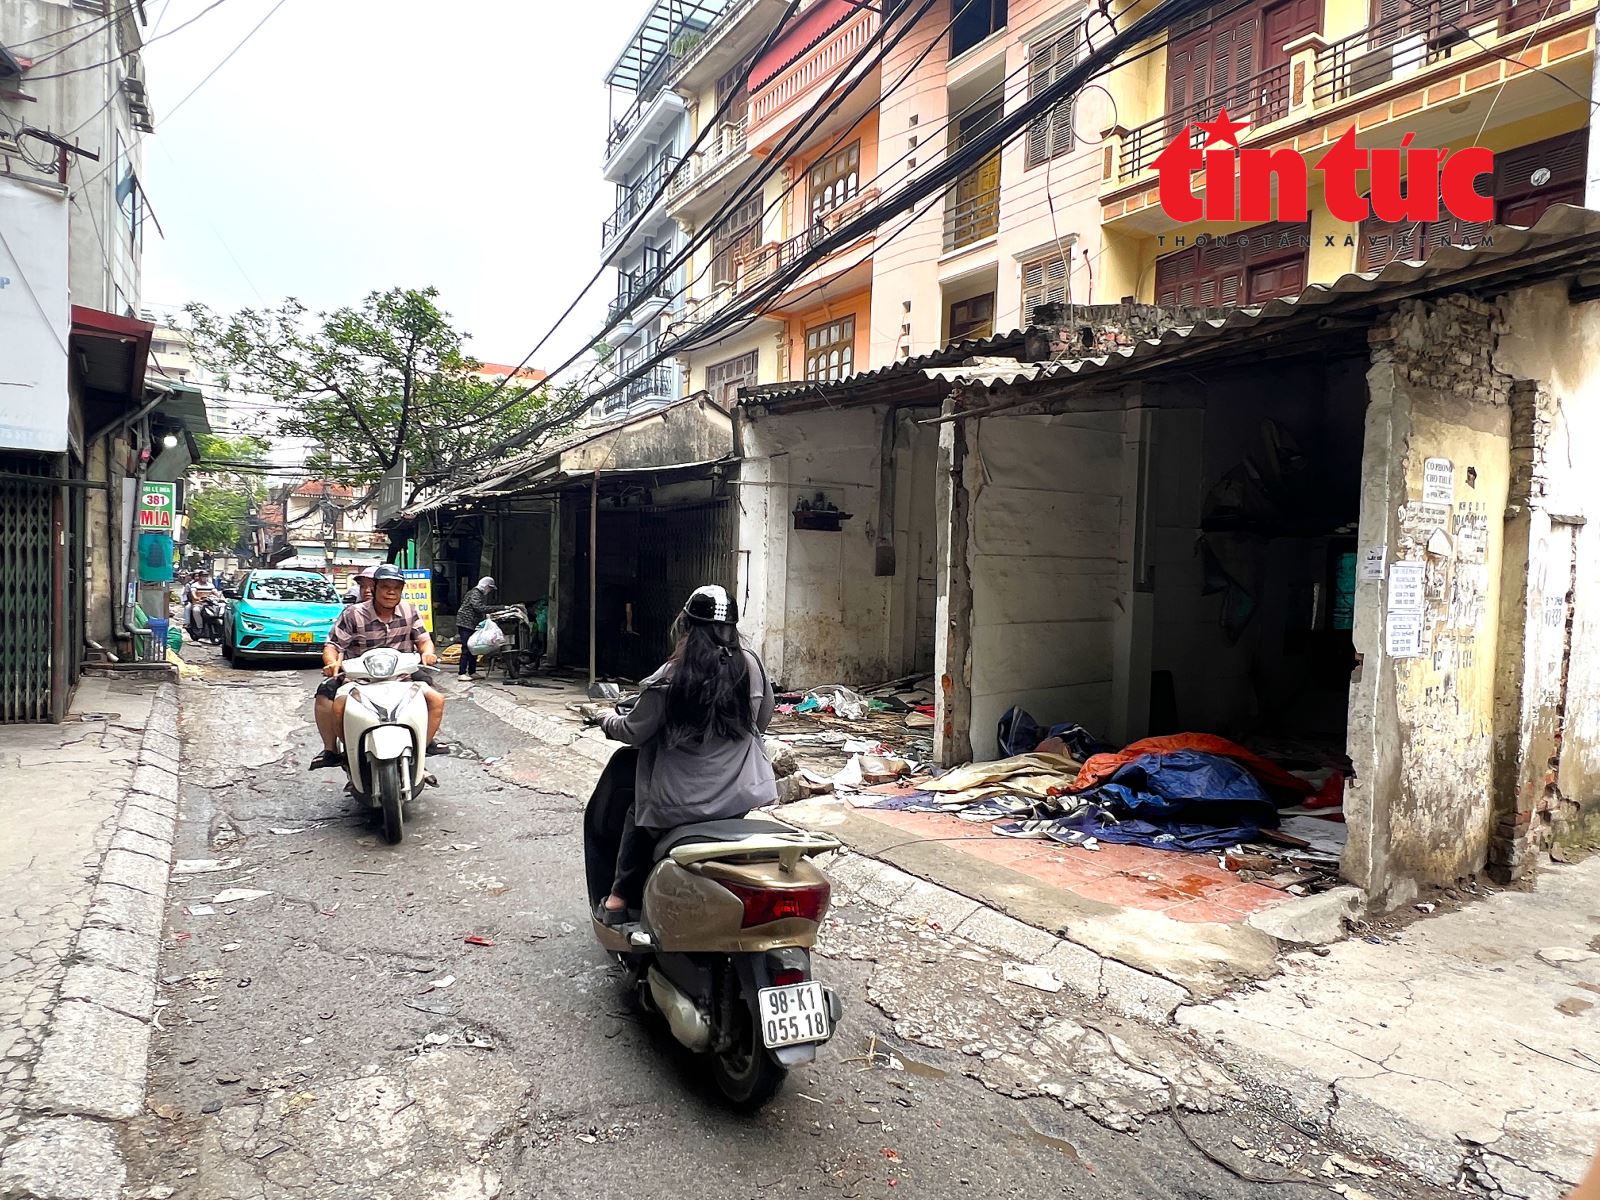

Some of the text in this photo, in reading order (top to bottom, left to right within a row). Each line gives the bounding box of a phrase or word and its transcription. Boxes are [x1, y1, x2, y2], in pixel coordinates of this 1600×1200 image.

[146, 495, 165, 505] 381
[768, 986, 815, 1016] 98-K1
[767, 1011, 825, 1043] 055.18
